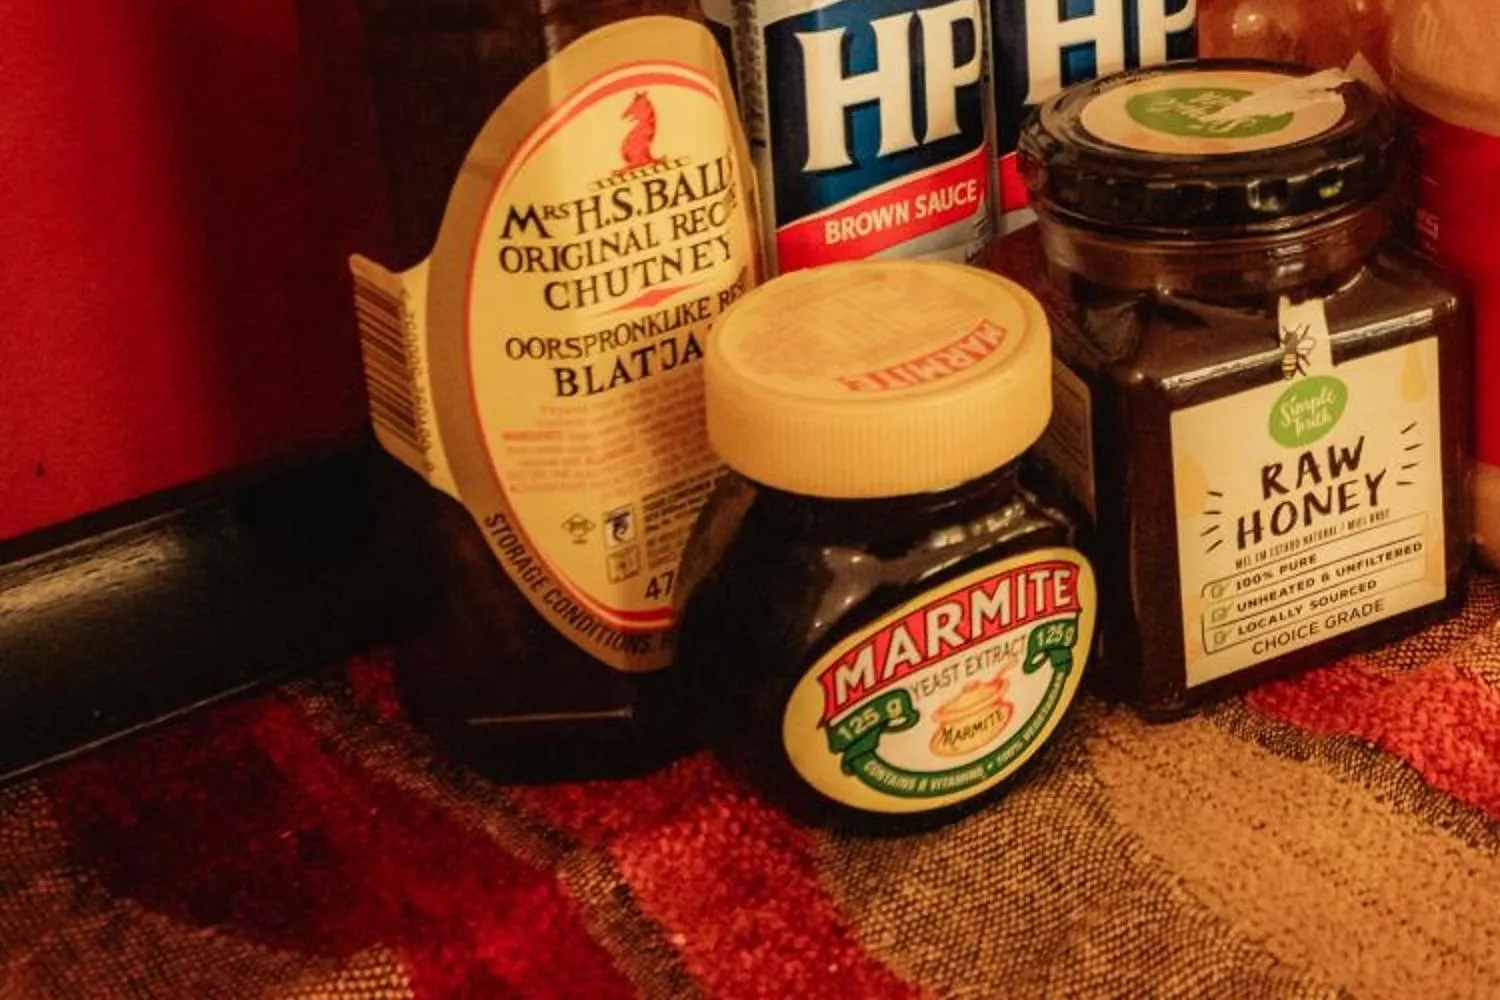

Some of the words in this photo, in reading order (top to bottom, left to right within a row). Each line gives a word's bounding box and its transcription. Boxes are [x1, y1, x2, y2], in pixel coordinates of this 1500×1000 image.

[499, 223, 660, 274] ORIGINAL
[670, 190, 734, 241] REC
[824, 199, 910, 245] BROWN
[914, 178, 977, 220] SAUCE
[543, 233, 732, 312] CHUTNEY
[505, 296, 712, 360] OORSPRONKLIKE
[552, 326, 711, 398] BLATJA
[1261, 435, 1365, 500] RAW
[1236, 468, 1387, 550] HONEY
[484, 511, 551, 593] STORAGE
[644, 570, 675, 602] 47
[1236, 567, 1274, 591] 100%
[1278, 553, 1318, 575] PURE
[1236, 577, 1315, 612] UNHEATED
[1335, 542, 1424, 578] UNFILTERED
[835, 569, 1072, 706] MARMITE
[1237, 605, 1305, 637] LOCALLY
[1308, 579, 1378, 610] SOURCED
[1251, 620, 1321, 656] CHOICE
[1324, 598, 1386, 630] GRADE
[909, 665, 960, 702] YEAST
[964, 634, 1028, 679] EXTRACT
